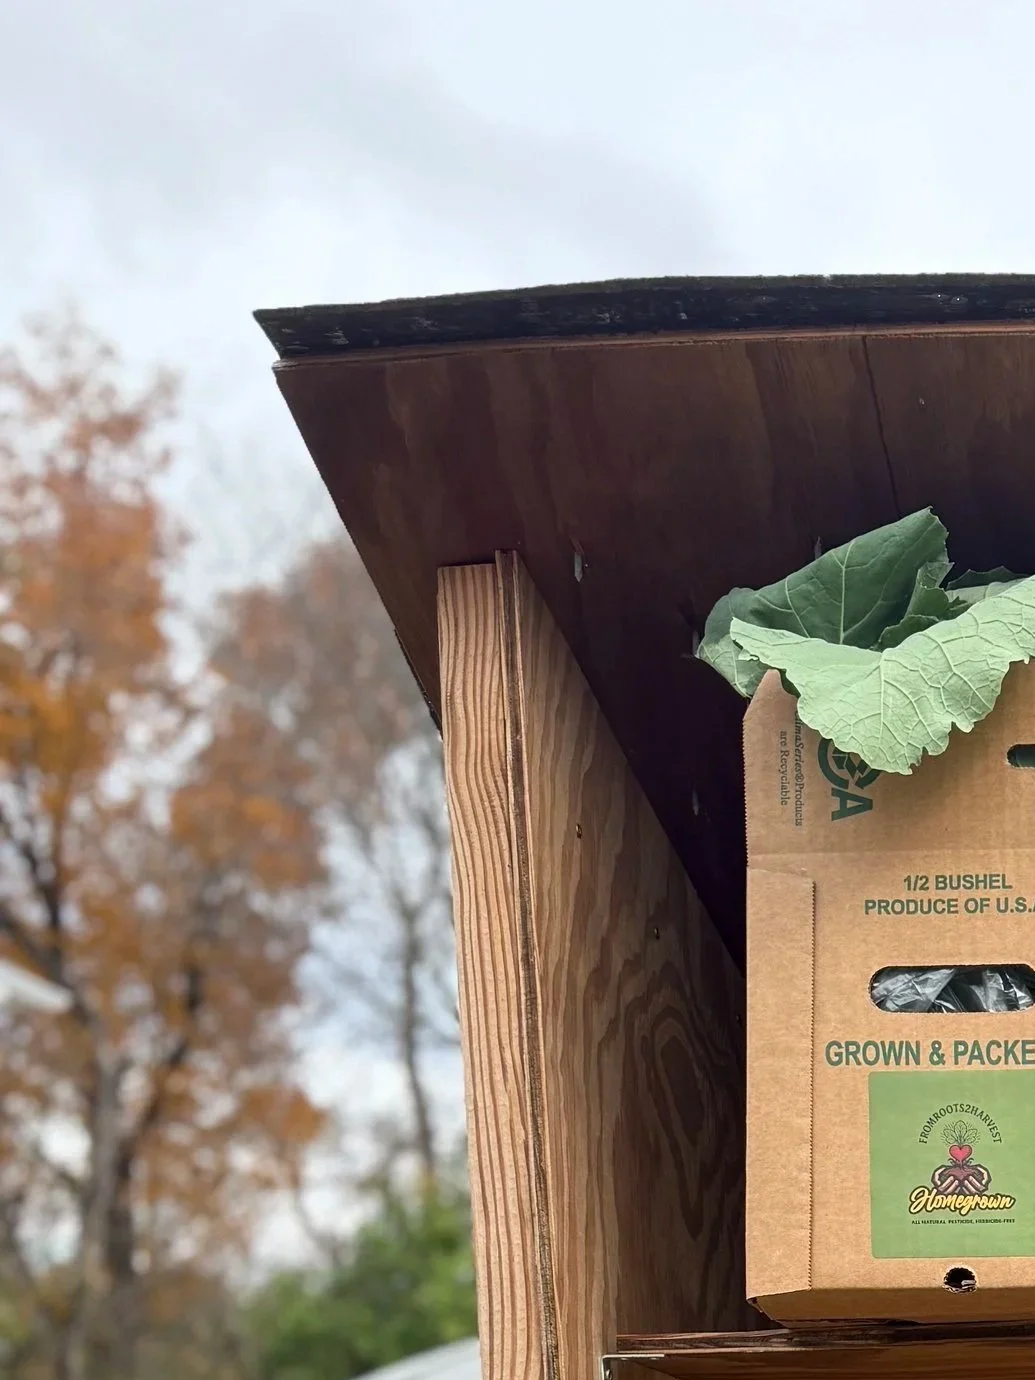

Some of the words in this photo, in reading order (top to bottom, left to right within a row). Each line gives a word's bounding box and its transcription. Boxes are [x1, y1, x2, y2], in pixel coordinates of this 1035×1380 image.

[780, 730, 788, 747] are
[779, 750, 790, 806] Recyclable
[903, 875, 929, 891] 1/2
[935, 874, 1012, 891] BUSHEL
[864, 899, 959, 916] PRODUCE
[964, 898, 990, 915] OF
[825, 1040, 921, 1066] GROWN
[928, 1040, 946, 1066] &
[919, 1103, 1002, 1144] FROMROOTS2HARVEST
[909, 1186, 1016, 1216] Homegrown
